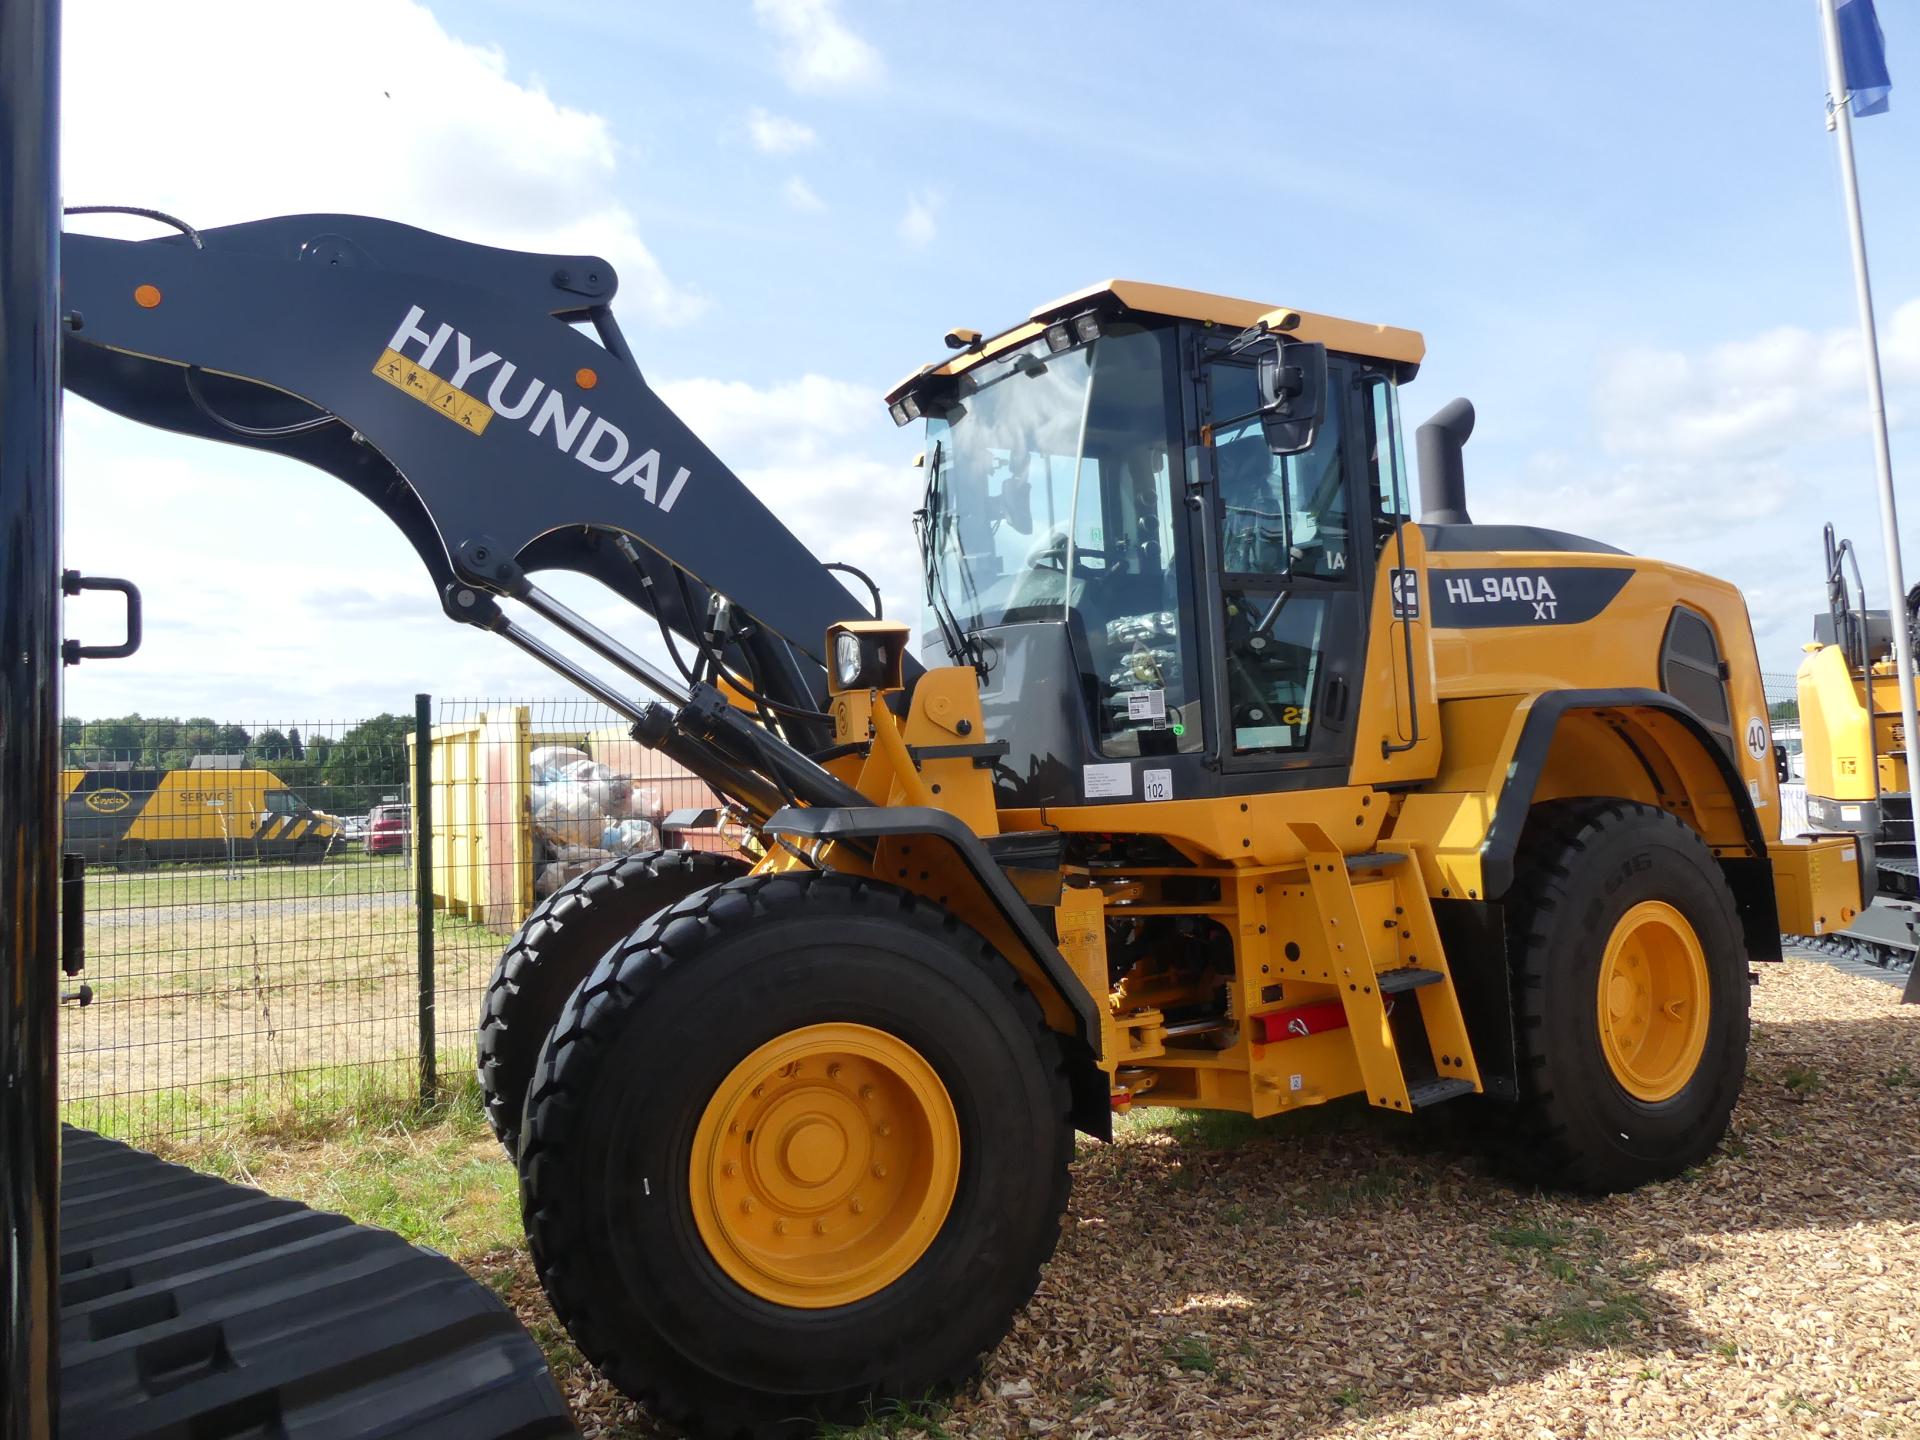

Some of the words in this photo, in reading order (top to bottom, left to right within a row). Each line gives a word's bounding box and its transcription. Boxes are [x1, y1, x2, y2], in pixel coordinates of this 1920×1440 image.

[388, 305, 691, 513] HYUNDAI
[1445, 576, 1556, 604] HL940A
[1532, 602, 1557, 620] XT
[1748, 726, 1766, 752] 40
[180, 792, 233, 802] SERVICE
[1147, 783, 1164, 798] 102
